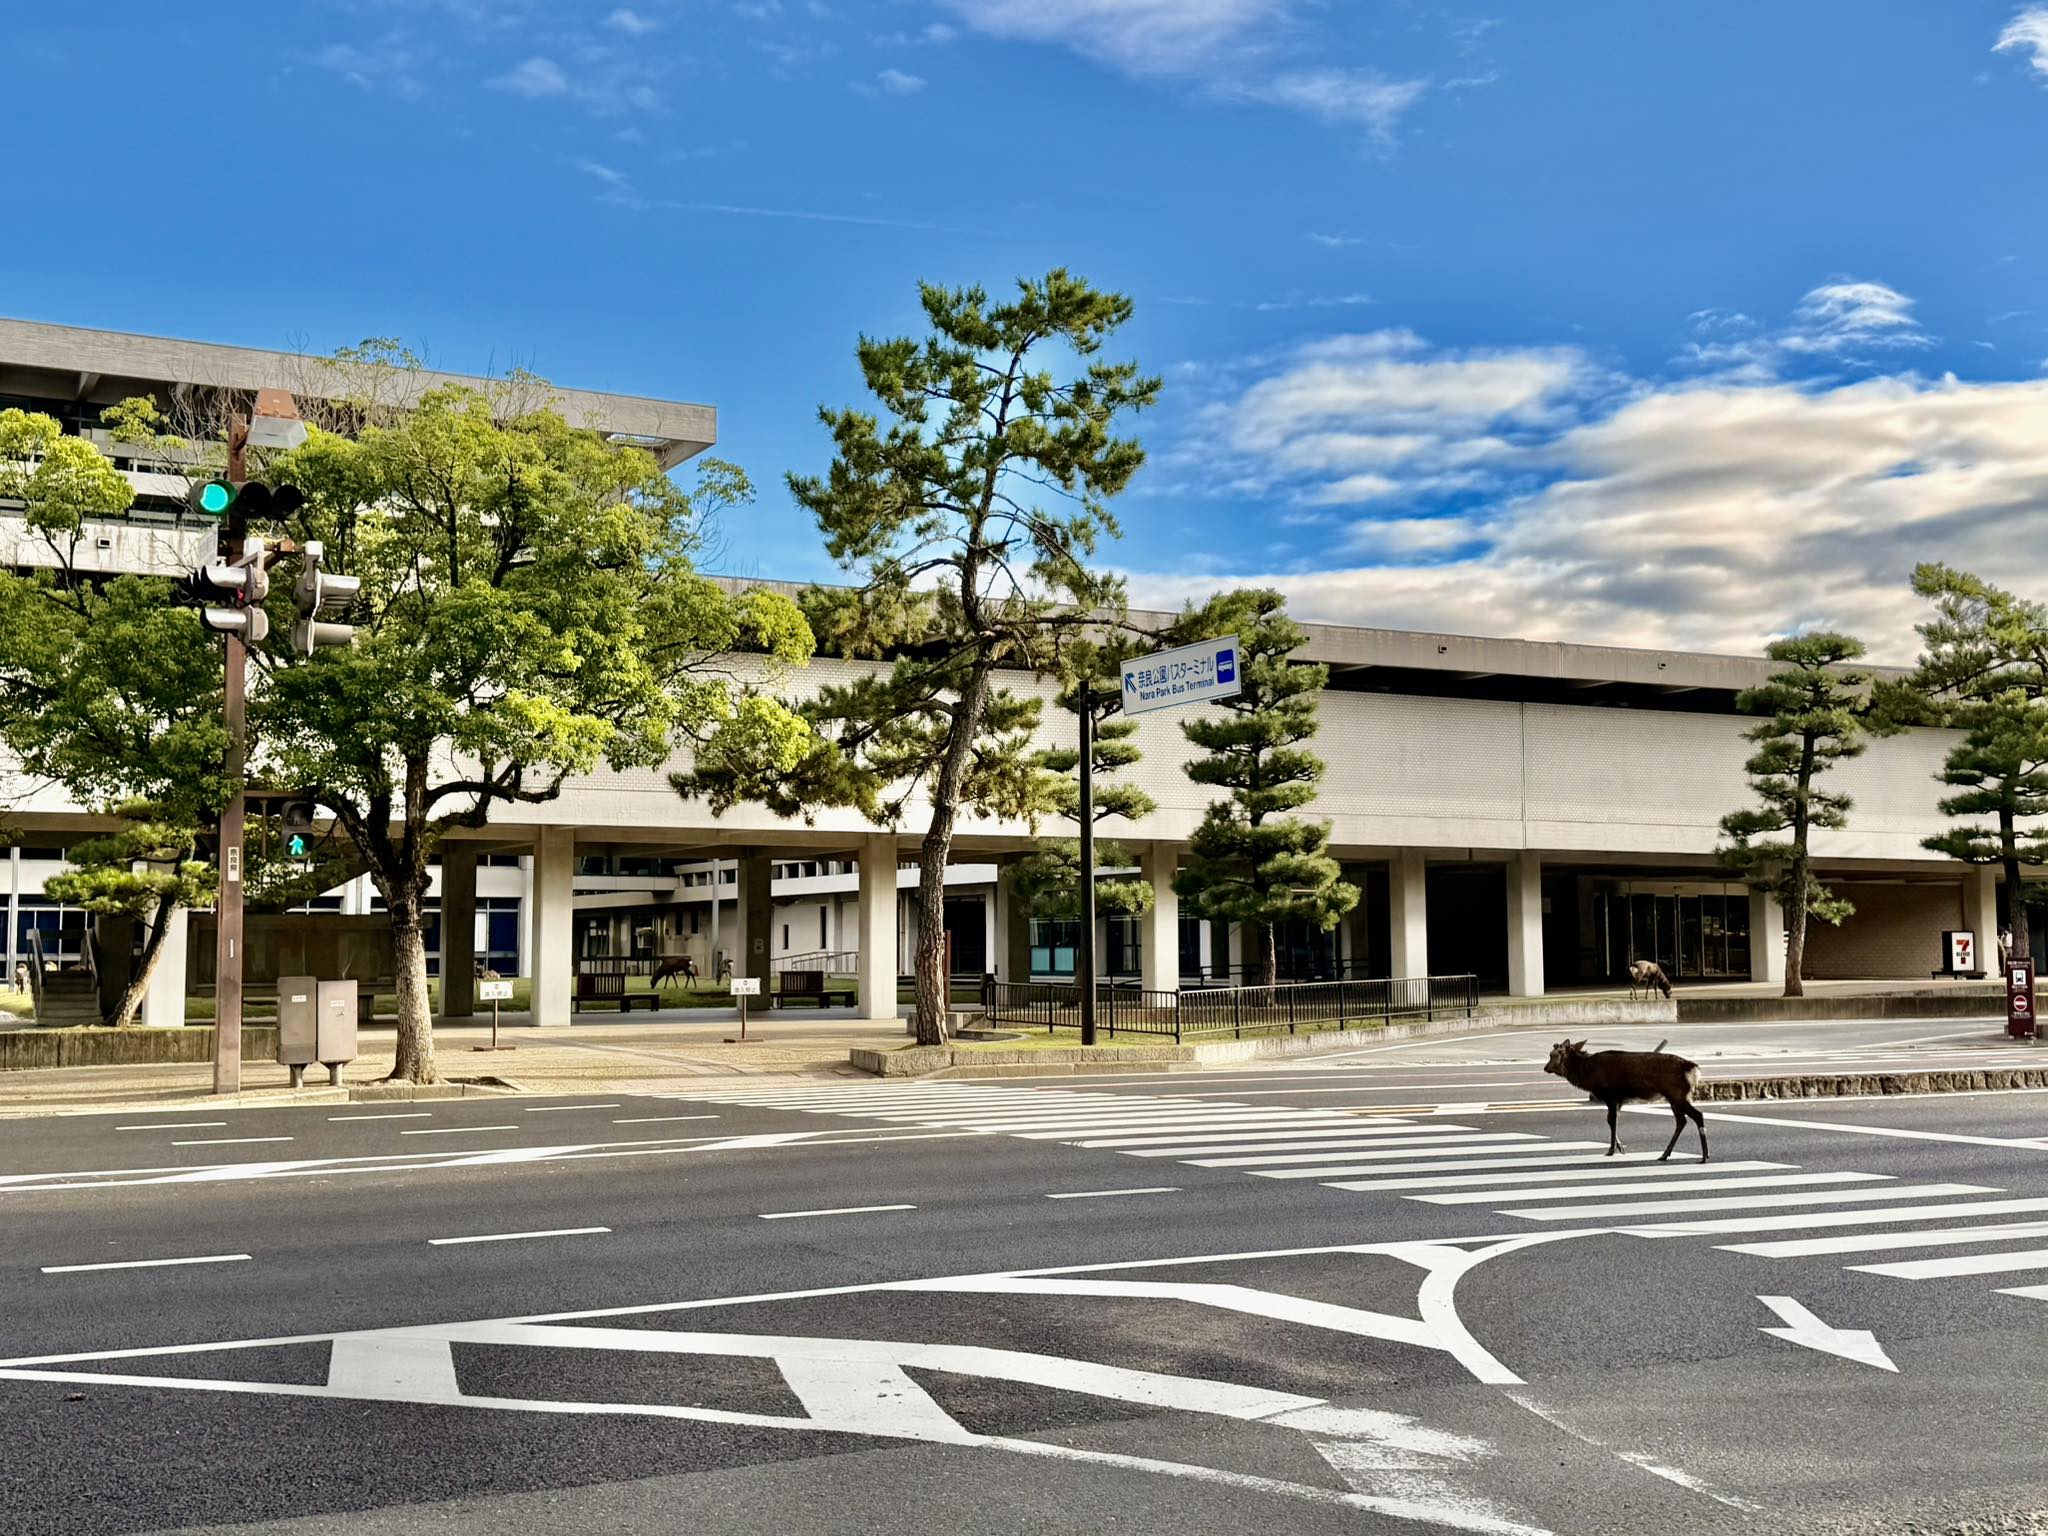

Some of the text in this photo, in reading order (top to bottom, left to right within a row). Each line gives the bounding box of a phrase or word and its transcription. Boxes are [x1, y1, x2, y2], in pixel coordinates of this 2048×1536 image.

[1138, 656, 1214, 688] 奈良公園バスターミナル
[1140, 677, 1214, 701] Nara Park Bus Terminal
